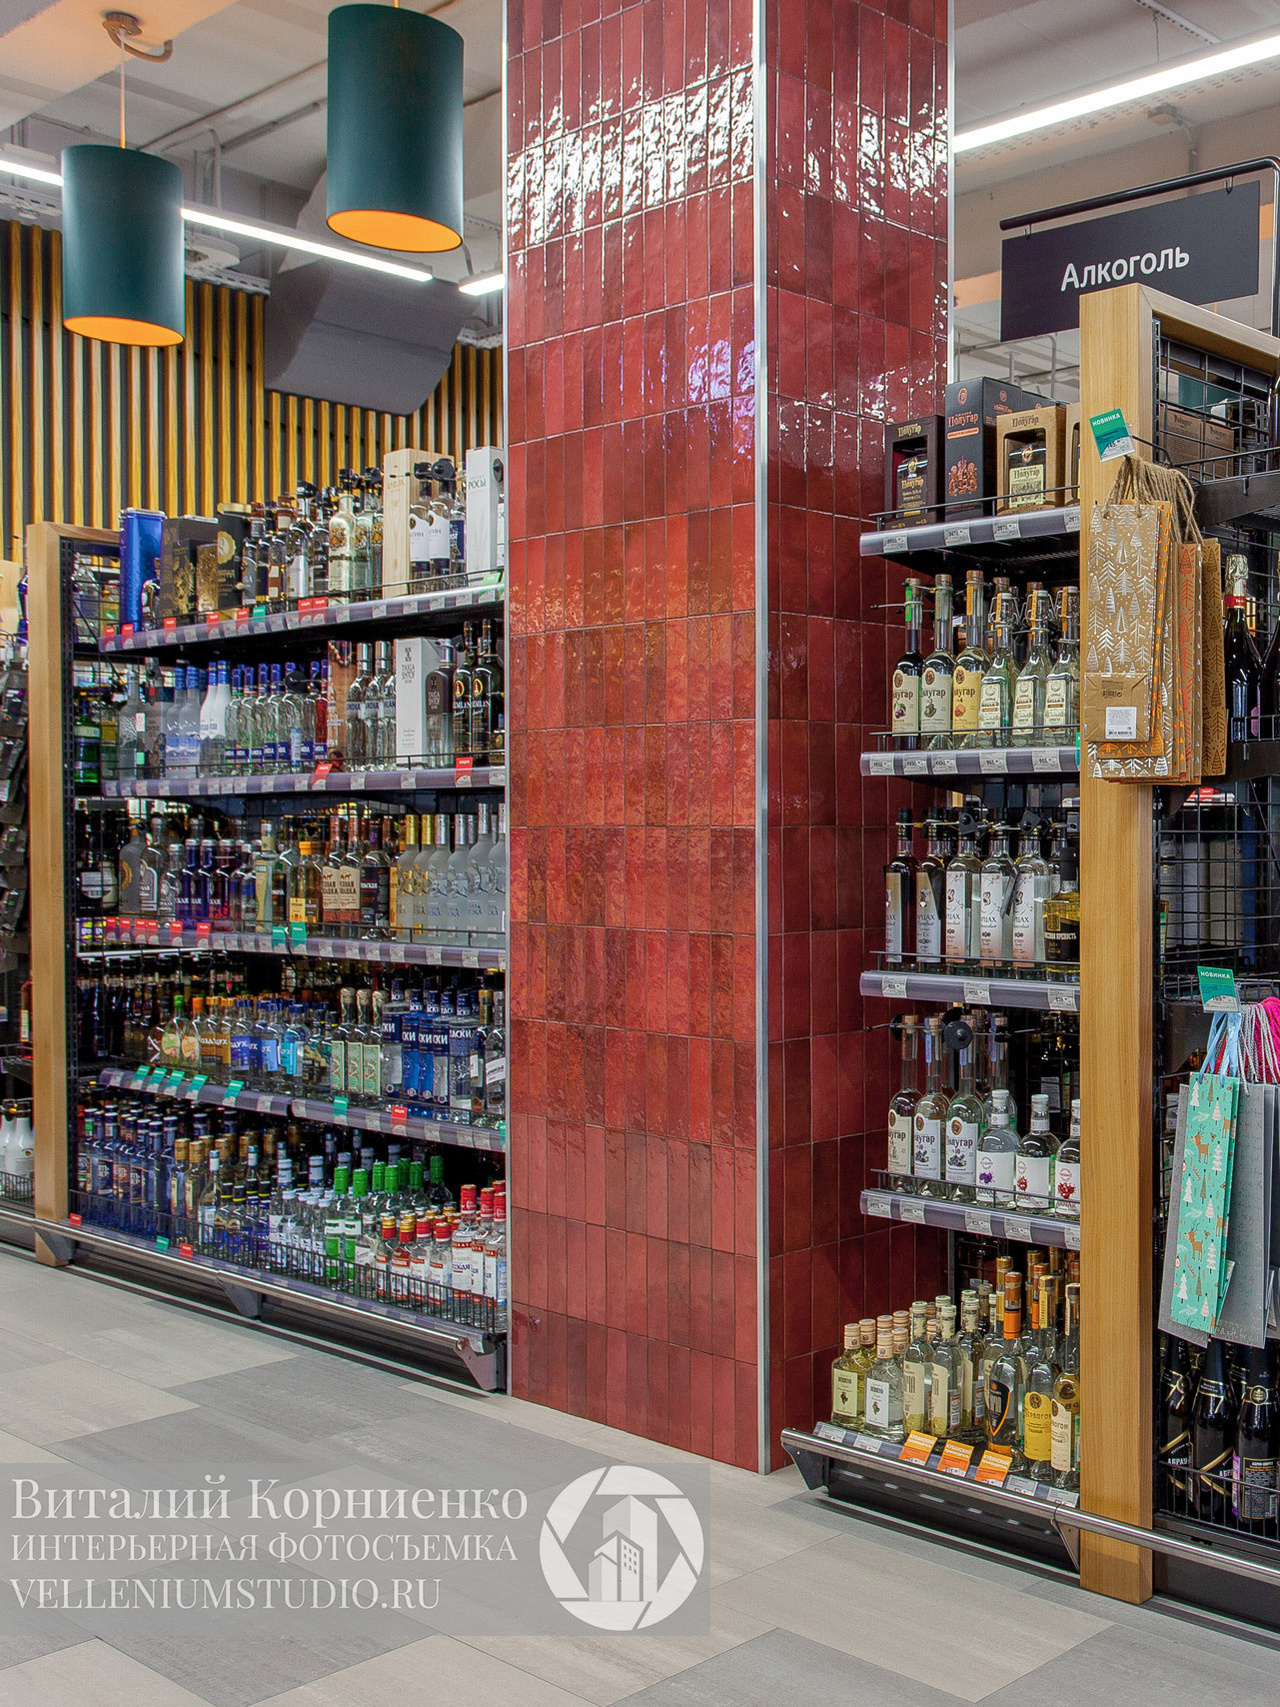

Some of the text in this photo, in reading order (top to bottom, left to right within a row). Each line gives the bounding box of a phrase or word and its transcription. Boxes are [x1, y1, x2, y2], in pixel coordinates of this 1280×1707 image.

[1060, 247, 1190, 292] Алкоголь
[1092, 412, 1121, 427] НОВИНКА
[1200, 971, 1231, 979] НОВИНКА
